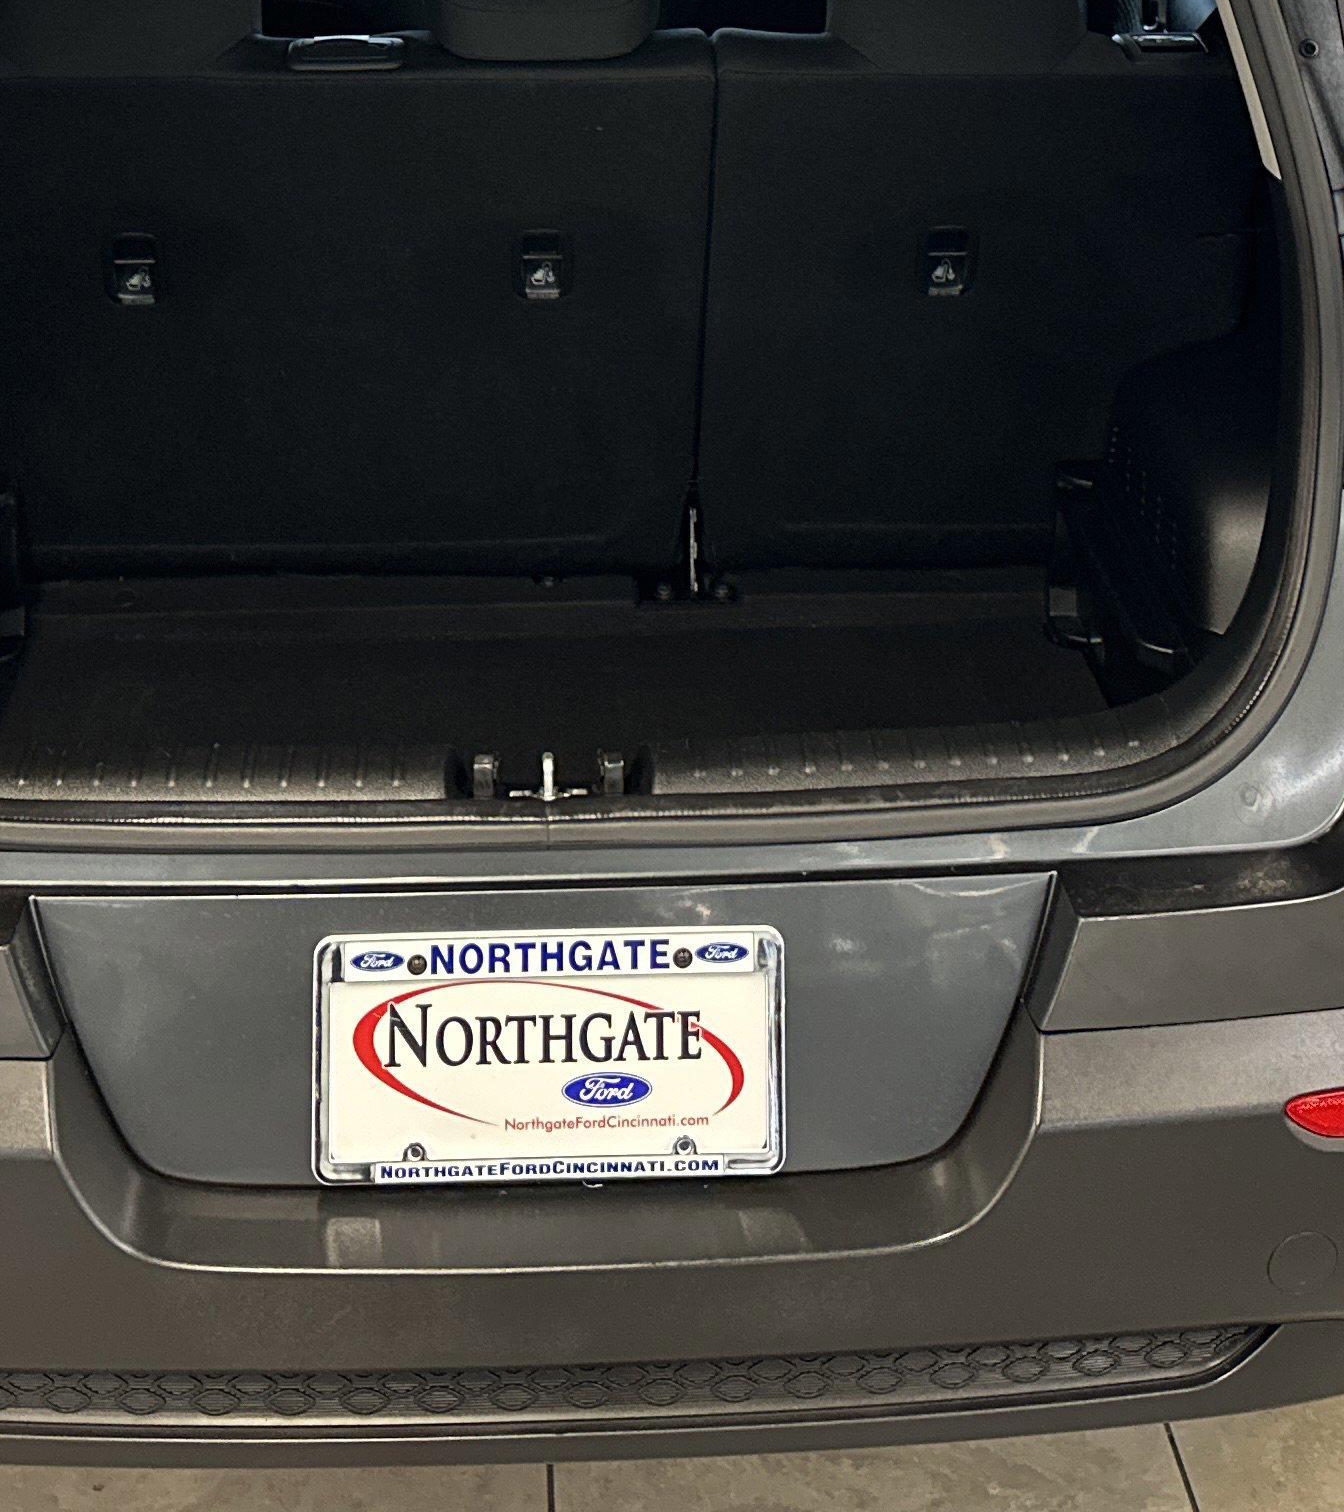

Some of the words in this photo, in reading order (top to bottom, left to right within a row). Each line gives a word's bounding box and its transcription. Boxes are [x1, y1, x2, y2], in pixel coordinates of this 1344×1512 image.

[360, 953, 395, 968] Ford
[430, 939, 670, 975] NORTHGATE
[704, 944, 738, 959] Ford
[384, 1003, 702, 1068] NORTHGATE
[579, 1076, 634, 1101] Ford
[505, 1115, 710, 1133] NorthgateFordCincinnati.com
[380, 1158, 719, 1180] NORTHGATEFORDCINCINNATI.COM
